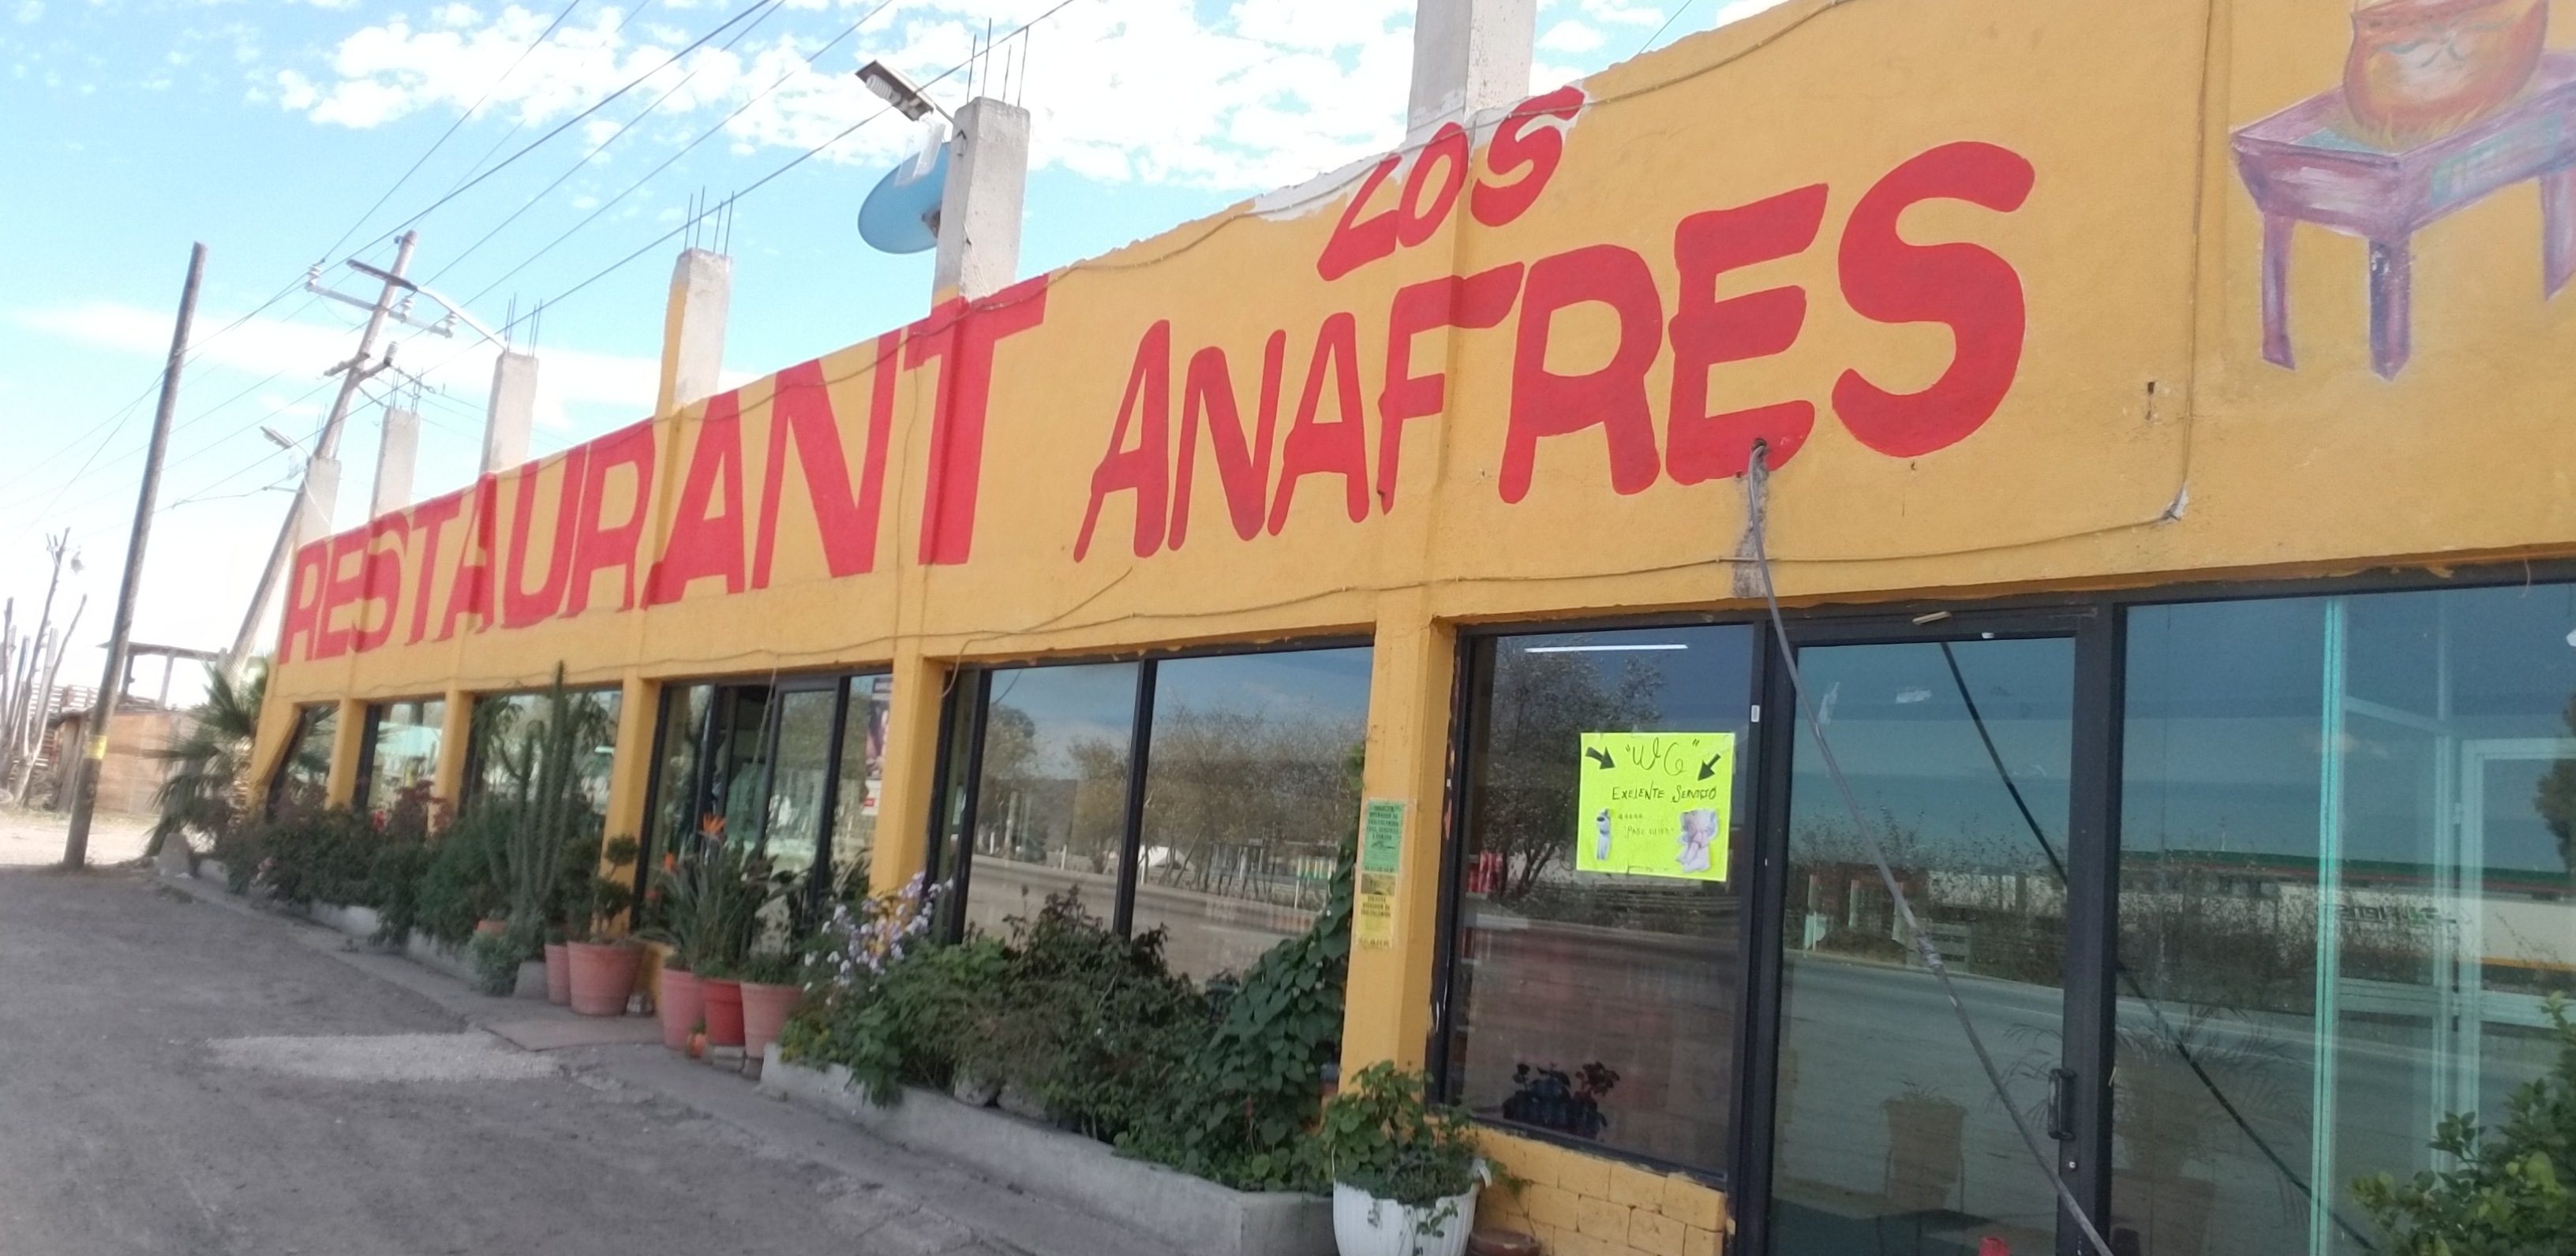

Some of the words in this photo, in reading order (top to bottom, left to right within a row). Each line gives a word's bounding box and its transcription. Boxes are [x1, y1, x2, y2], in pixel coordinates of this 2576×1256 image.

[1315, 85, 1586, 282] LOS
[278, 273, 1050, 667] RESTAURANT
[1071, 140, 2037, 564] ANAFRES
[1612, 780, 1666, 801] EXELENTE
